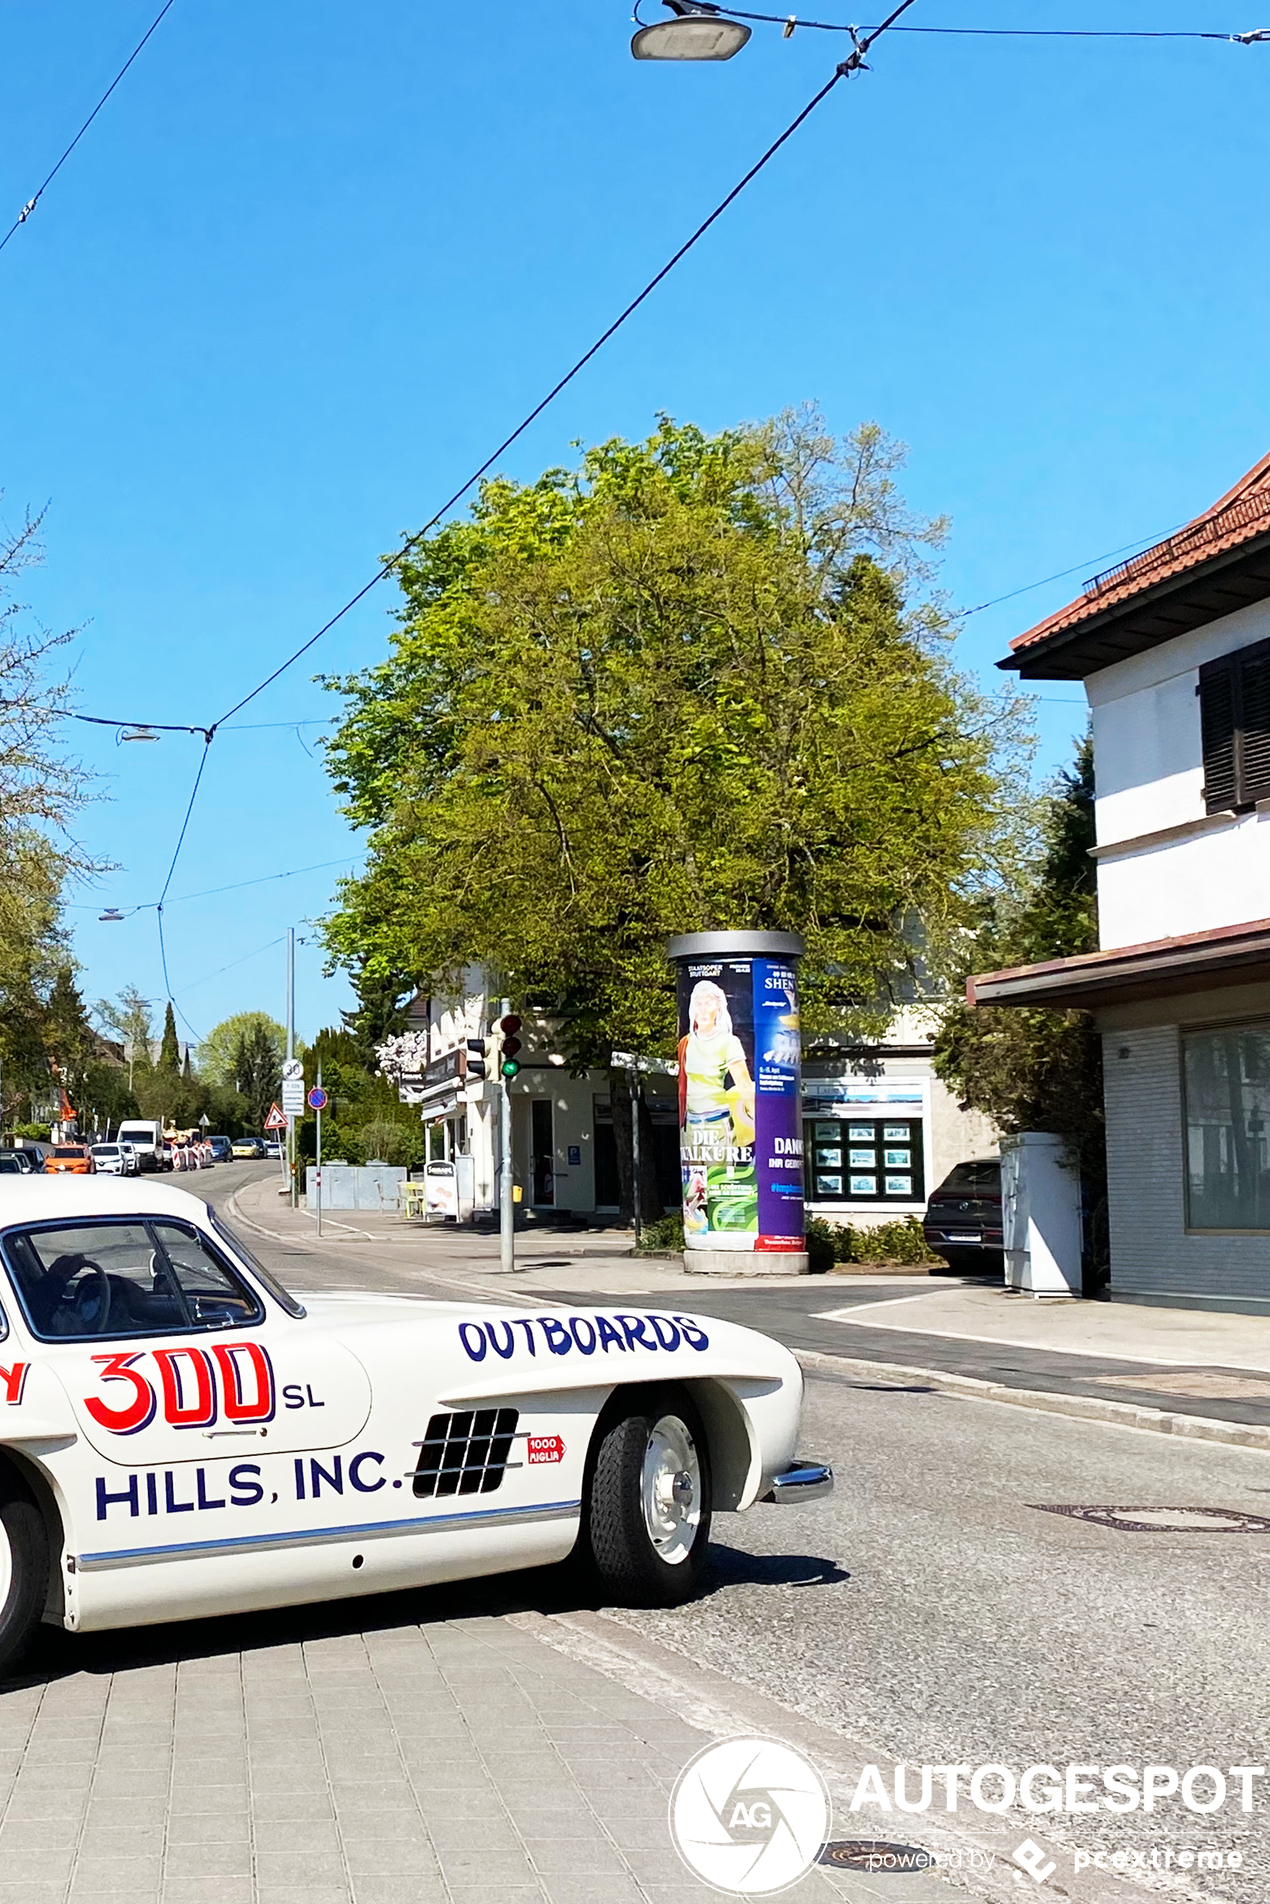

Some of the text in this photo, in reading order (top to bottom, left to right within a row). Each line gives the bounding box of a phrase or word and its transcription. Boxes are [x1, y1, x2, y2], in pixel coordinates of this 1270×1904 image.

[693, 1130, 719, 1145] DIE
[458, 1314, 709, 1362] OUTBOARDS
[83, 1342, 325, 1436] 300 SL
[530, 1438, 557, 1449] 1000
[95, 1451, 402, 1520] HILLS, INC.
